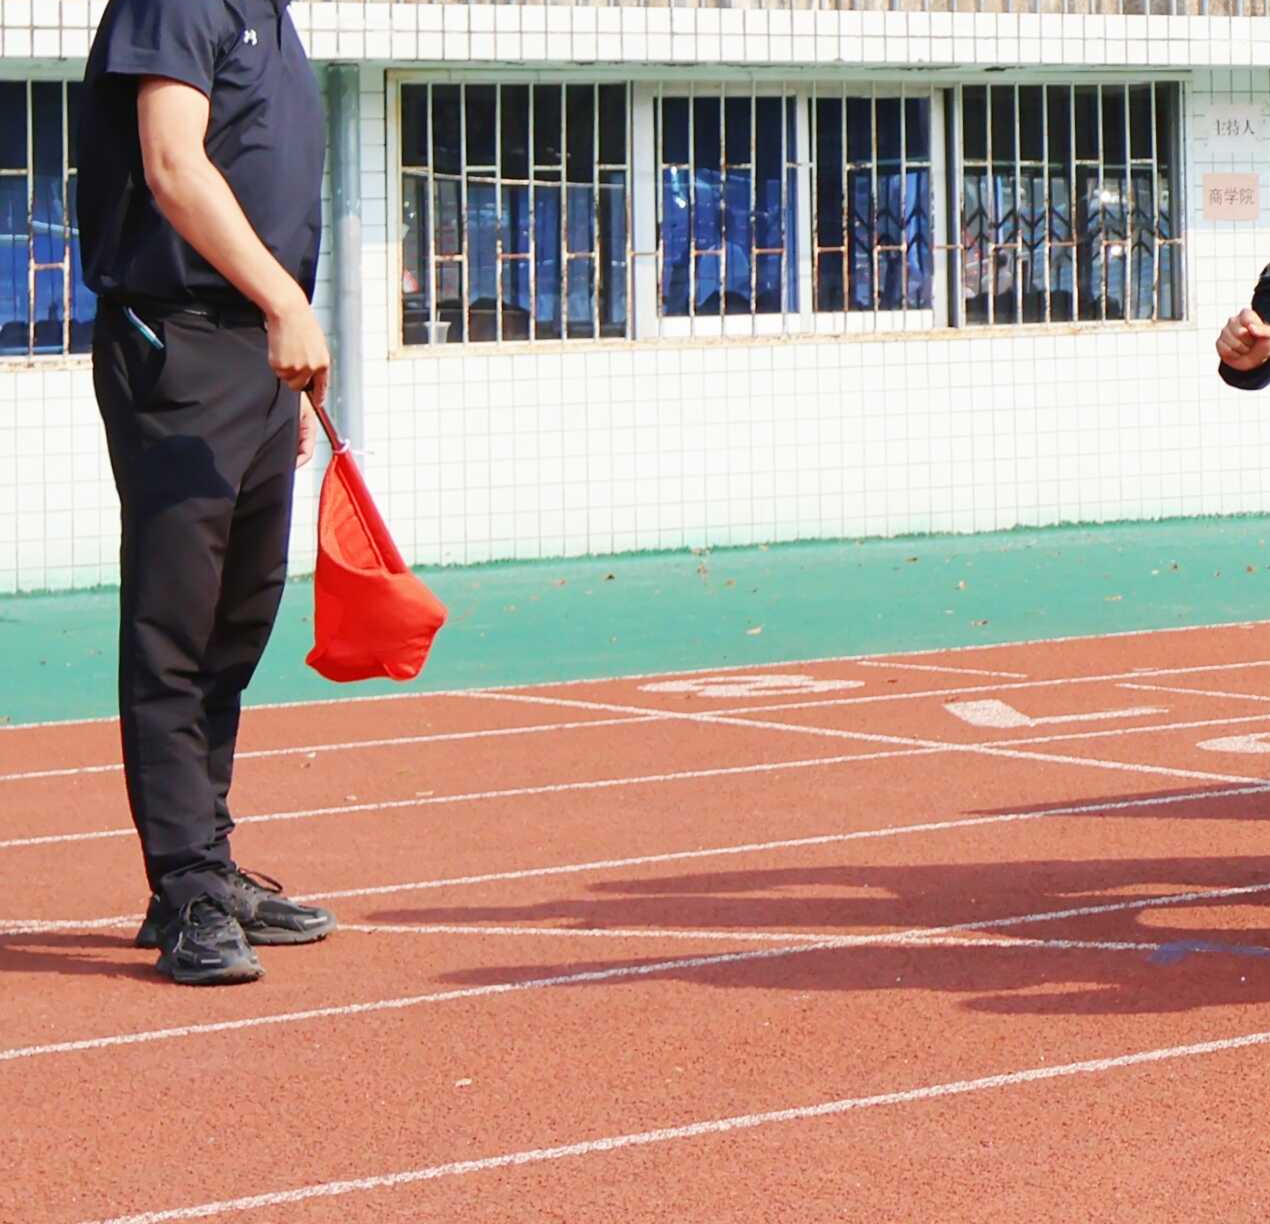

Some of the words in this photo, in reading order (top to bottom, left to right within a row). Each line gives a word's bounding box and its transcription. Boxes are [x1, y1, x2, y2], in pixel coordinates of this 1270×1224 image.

[1215, 119, 1256, 137] 主持人
[1208, 187, 1256, 206] 商学院
